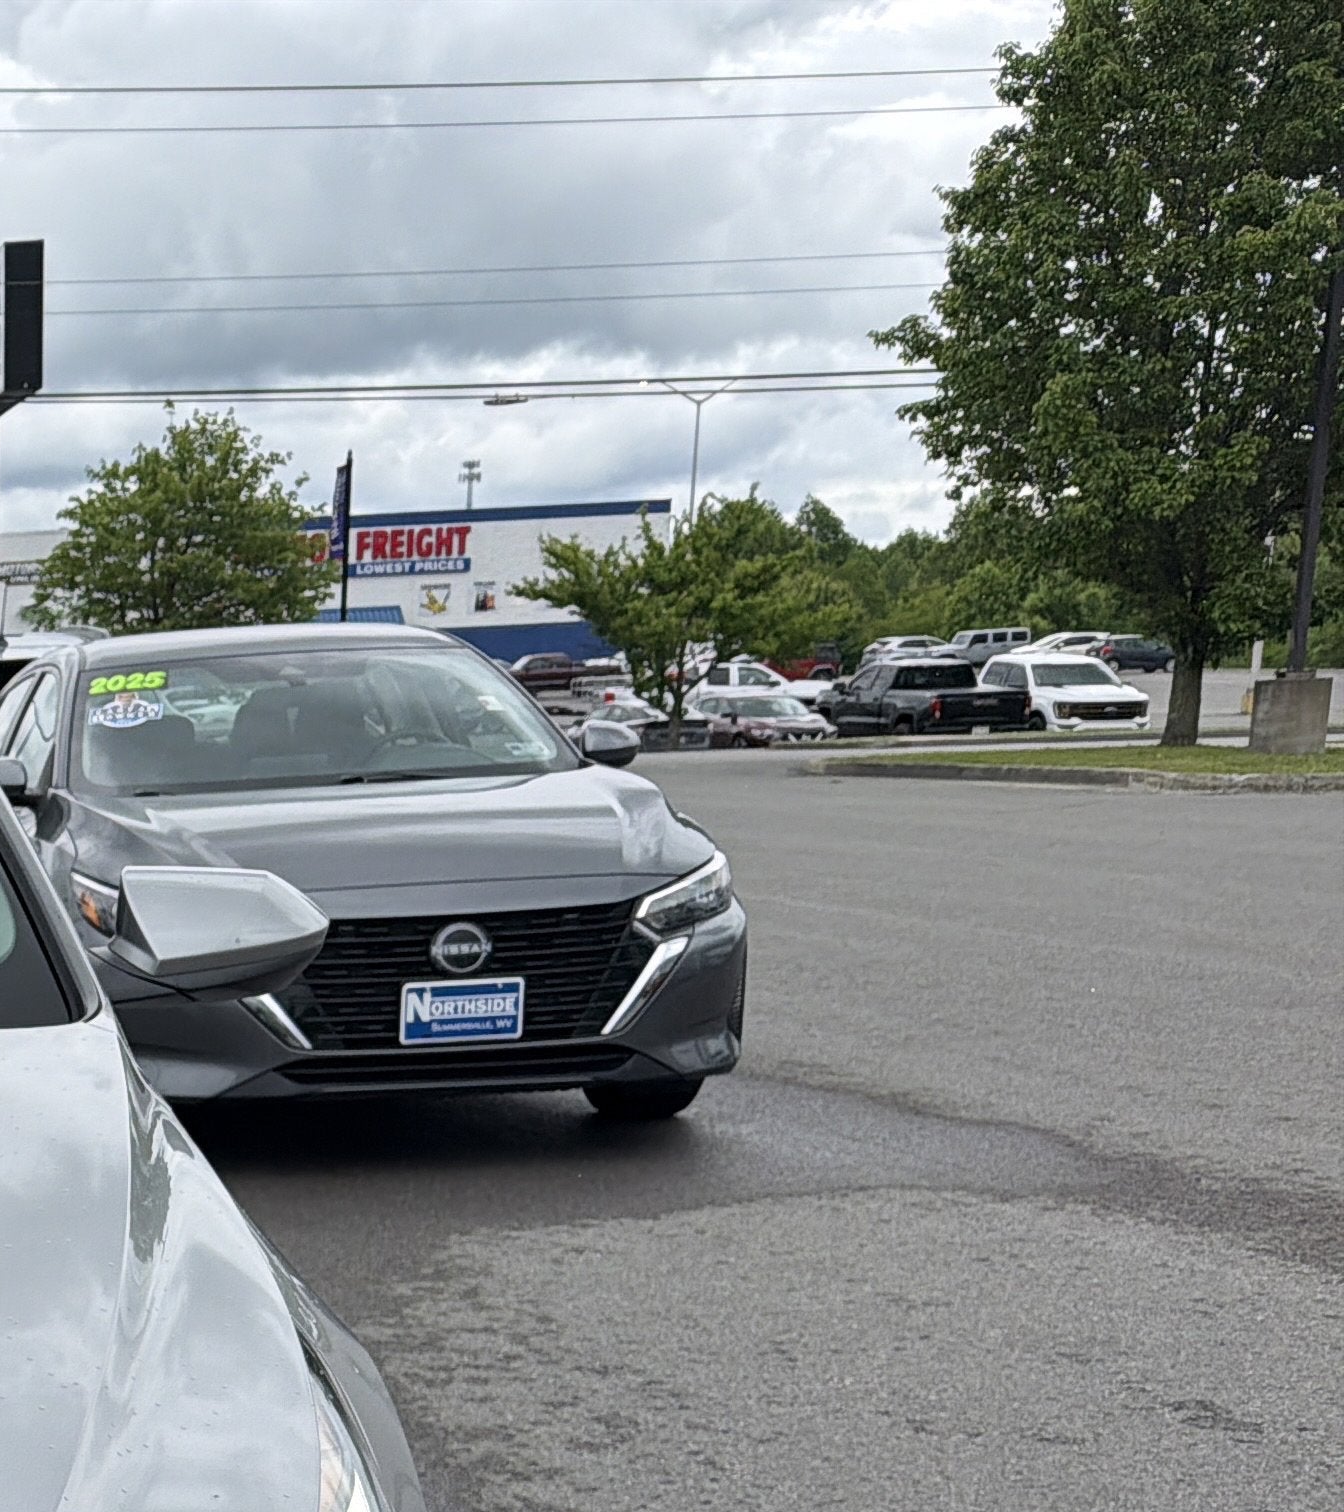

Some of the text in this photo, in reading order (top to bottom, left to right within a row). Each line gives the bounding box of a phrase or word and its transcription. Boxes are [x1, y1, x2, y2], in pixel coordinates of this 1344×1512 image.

[355, 525, 471, 561] FREIGHT
[356, 559, 465, 574] LOWEST PRICES
[88, 671, 167, 695] 2025
[431, 942, 491, 957] NISSAN
[496, 1018, 514, 1029] WV
